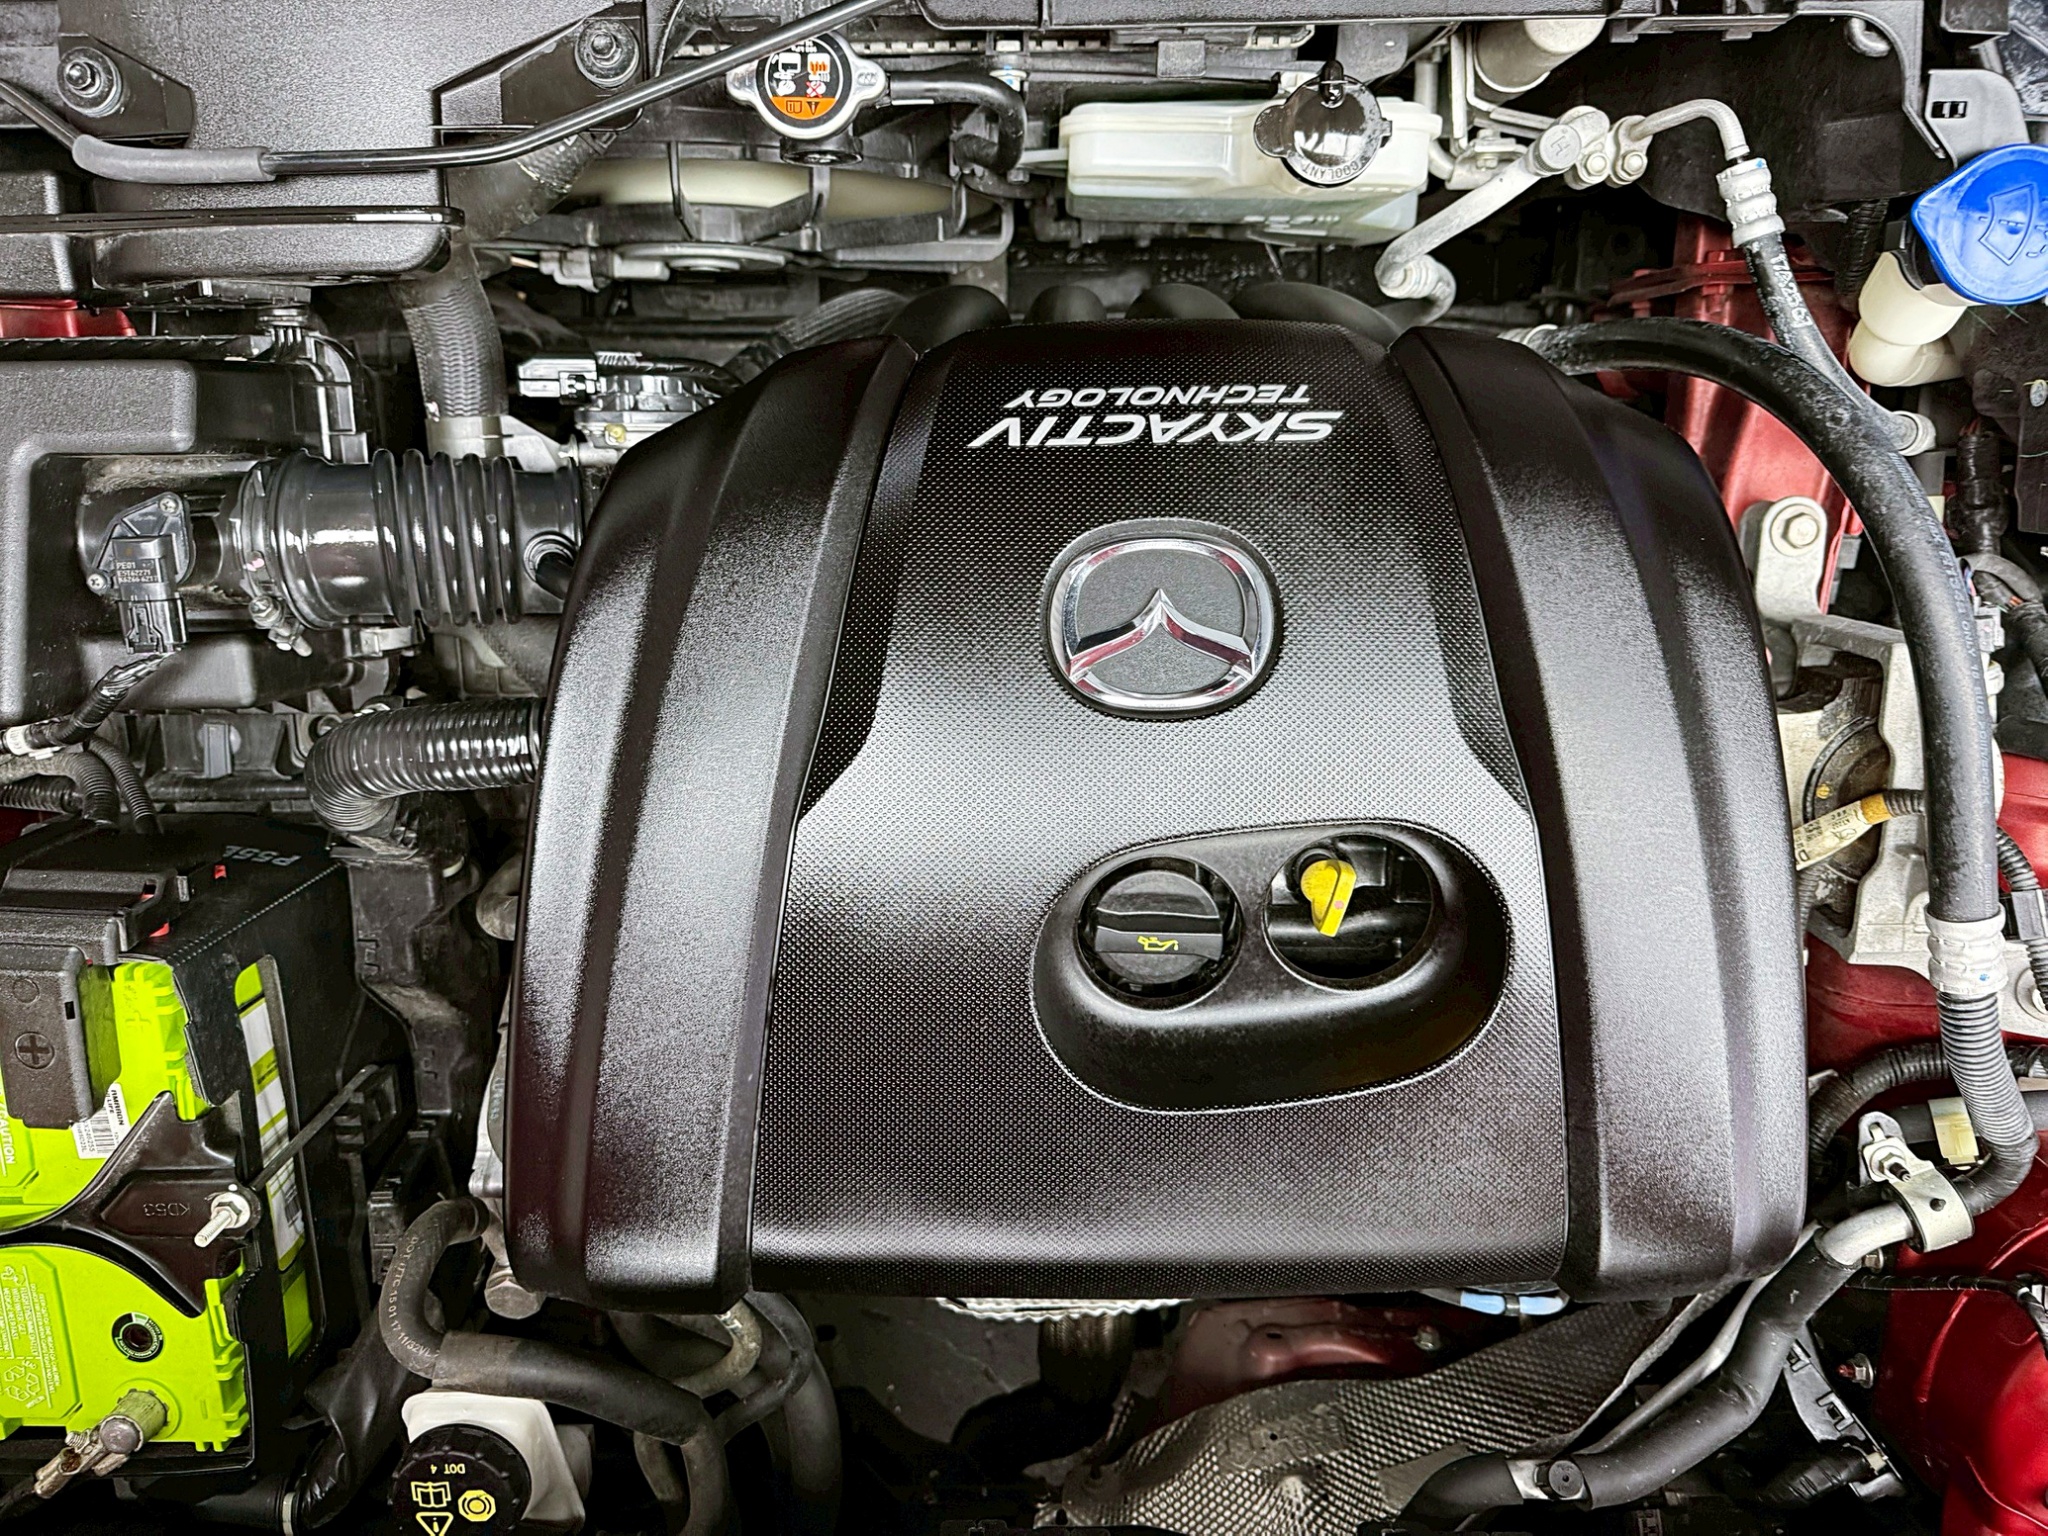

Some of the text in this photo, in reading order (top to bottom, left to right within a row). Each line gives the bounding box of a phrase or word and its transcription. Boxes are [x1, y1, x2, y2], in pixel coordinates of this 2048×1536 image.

[1302, 161, 1360, 181] COOLANT
[1003, 383, 1310, 409] TECHNOLOGY
[966, 411, 1344, 448] SKYACTIV
[1962, 620, 1977, 657] ONLY
[111, 1089, 124, 1126] AMARON
[429, 1463, 466, 1475] DOT 4
